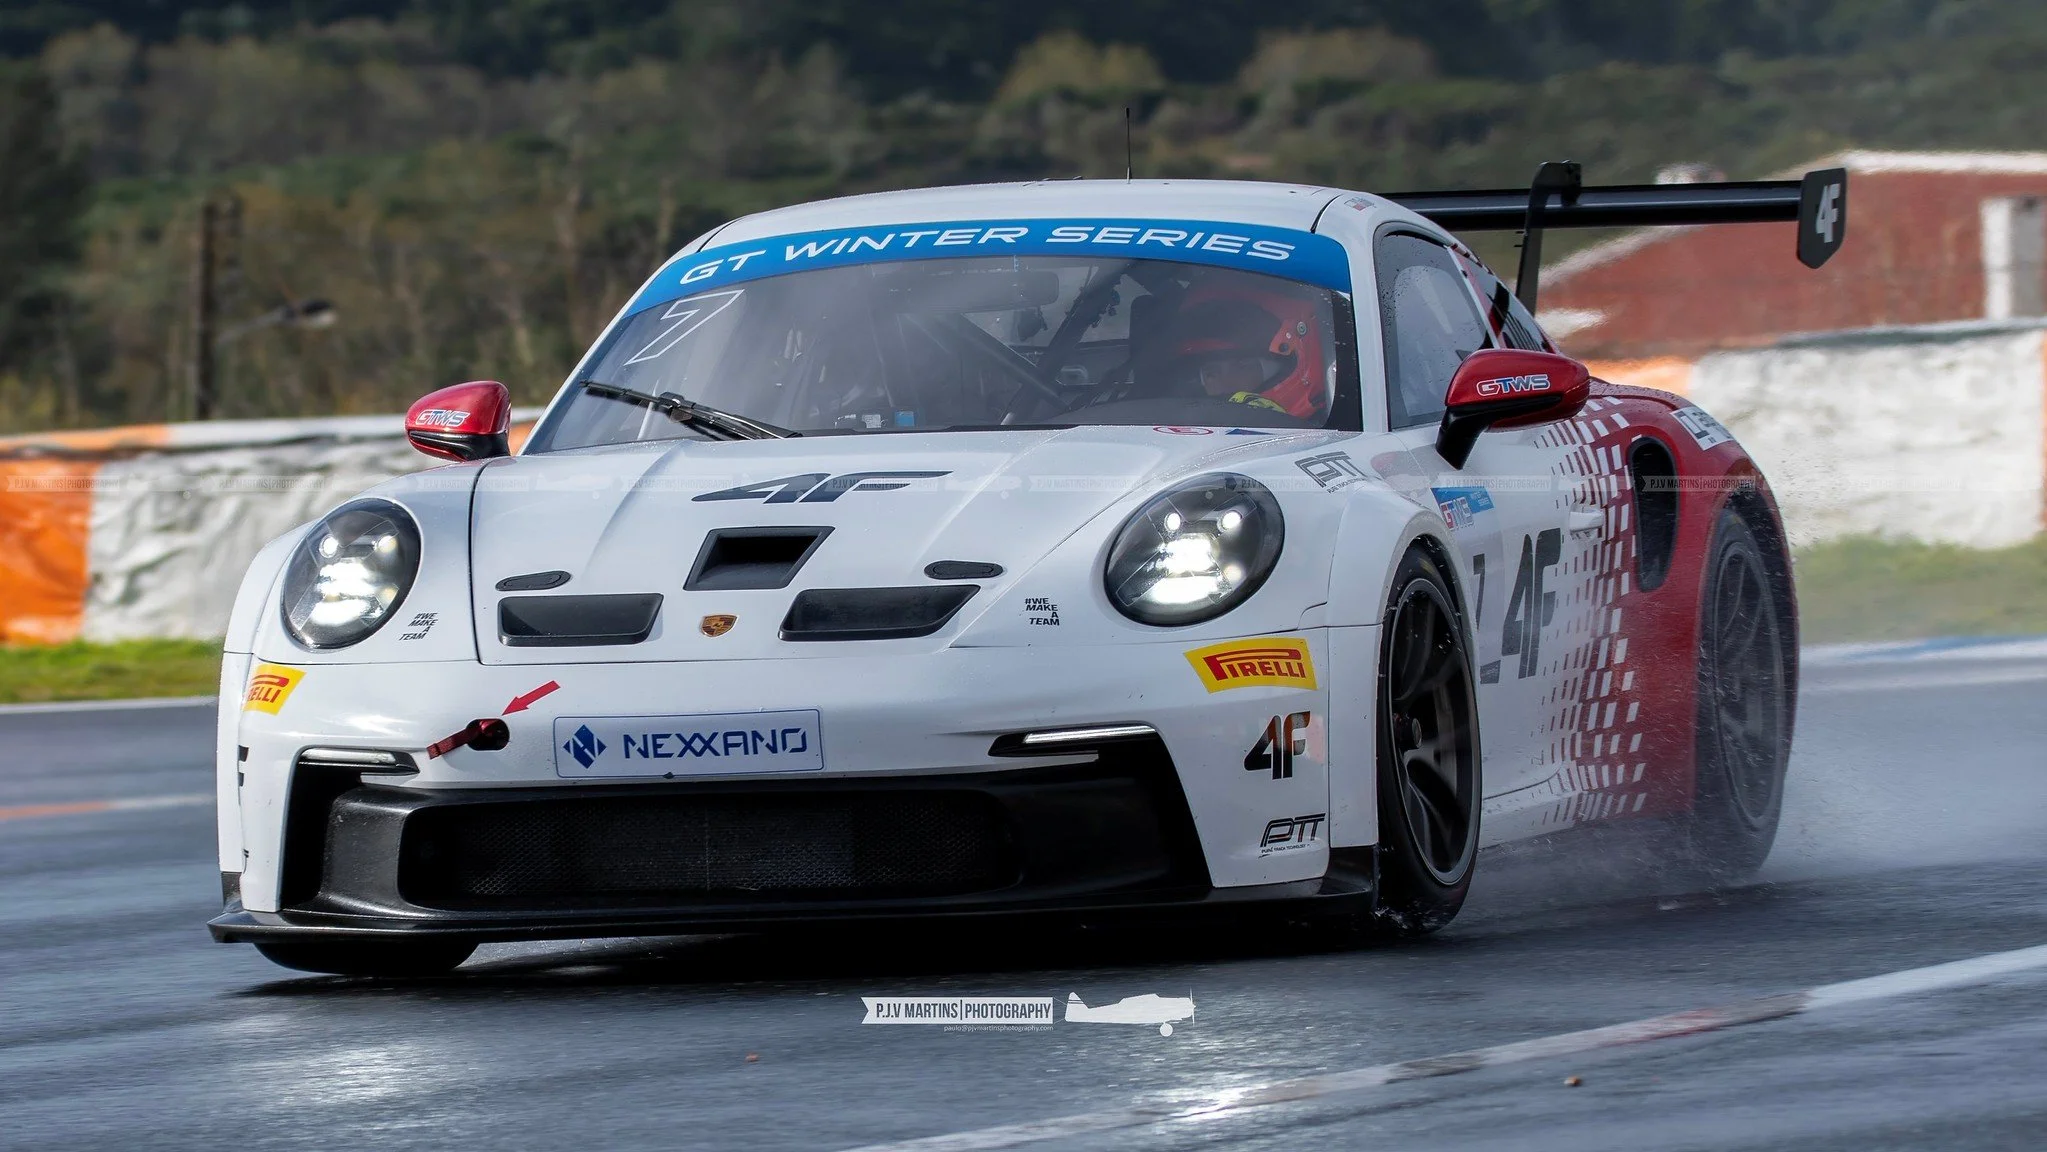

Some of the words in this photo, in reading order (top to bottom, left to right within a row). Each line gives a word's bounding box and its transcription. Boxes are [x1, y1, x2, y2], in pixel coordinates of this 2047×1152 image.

[1815, 183, 1841, 243] 4F
[680, 250, 767, 285] GT
[784, 226, 1021, 262] WINTER
[1045, 226, 1296, 262] SERIES
[624, 289, 745, 367] 7
[1476, 374, 1551, 397] GTWS
[415, 409, 471, 427] GTWS
[691, 470, 954, 505] 4F
[1025, 604, 1059, 612] MAKE
[1501, 528, 1561, 680] 4F
[398, 632, 427, 640] TEAM
[1029, 618, 1060, 626] TEAM
[1203, 649, 1307, 681] PIRELLI
[624, 726, 808, 760] NEXXANO
[1244, 711, 1311, 780] 4F
[1260, 813, 1327, 848] PTT
